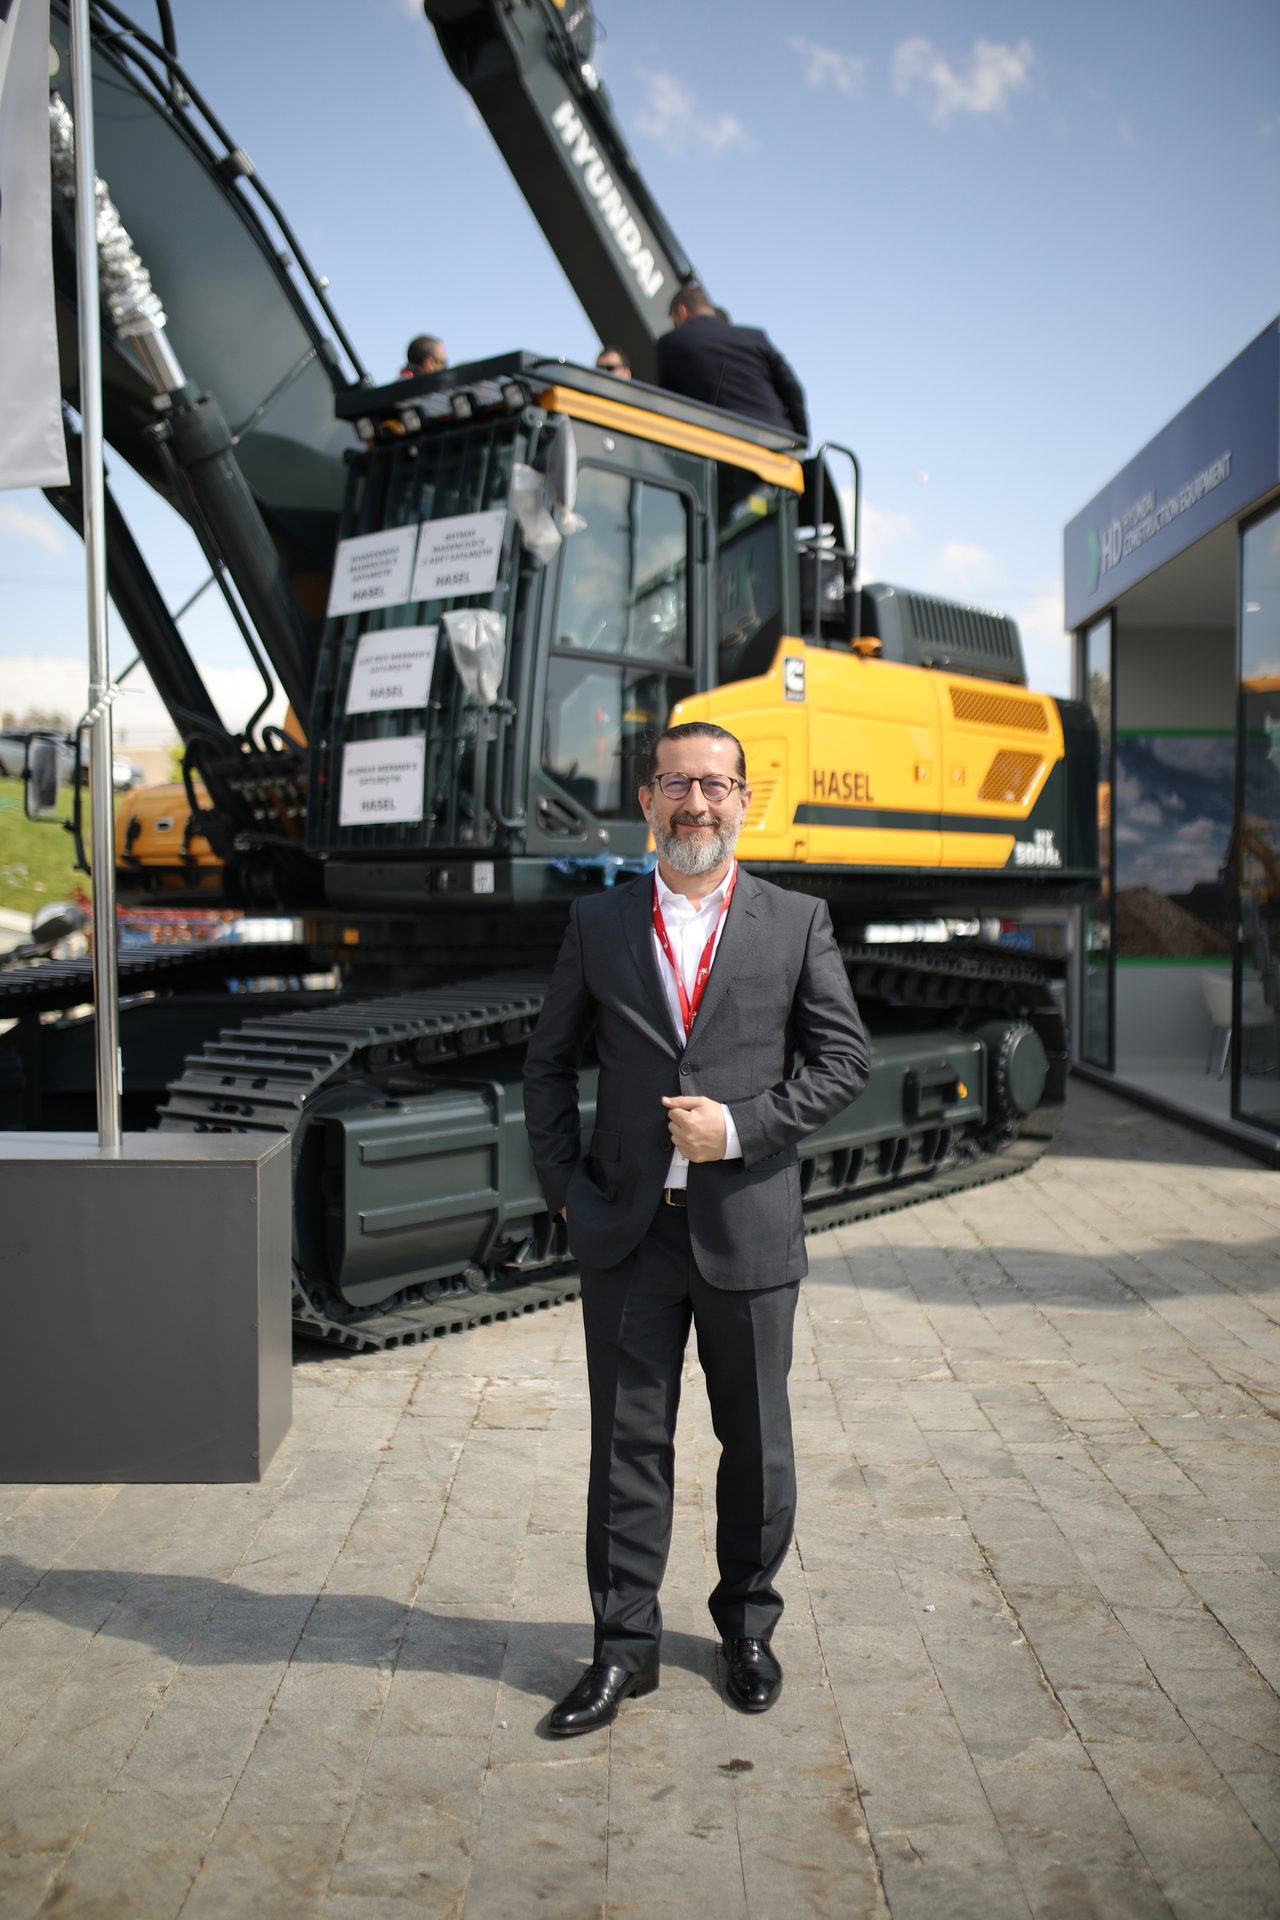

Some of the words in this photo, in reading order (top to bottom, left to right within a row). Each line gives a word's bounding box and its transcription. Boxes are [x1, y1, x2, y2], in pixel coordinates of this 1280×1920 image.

[550, 99, 665, 300] HYUNDAI
[1124, 494, 1179, 557] CONSTRUCTION
[1180, 450, 1233, 513] EQUIPMENT
[1101, 519, 1124, 575] HD
[435, 571, 471, 587] HASEL
[352, 586, 385, 602] HASEL
[369, 685, 405, 700] HASEL
[812, 769, 874, 802] HASEL
[360, 797, 396, 812] HASEL
